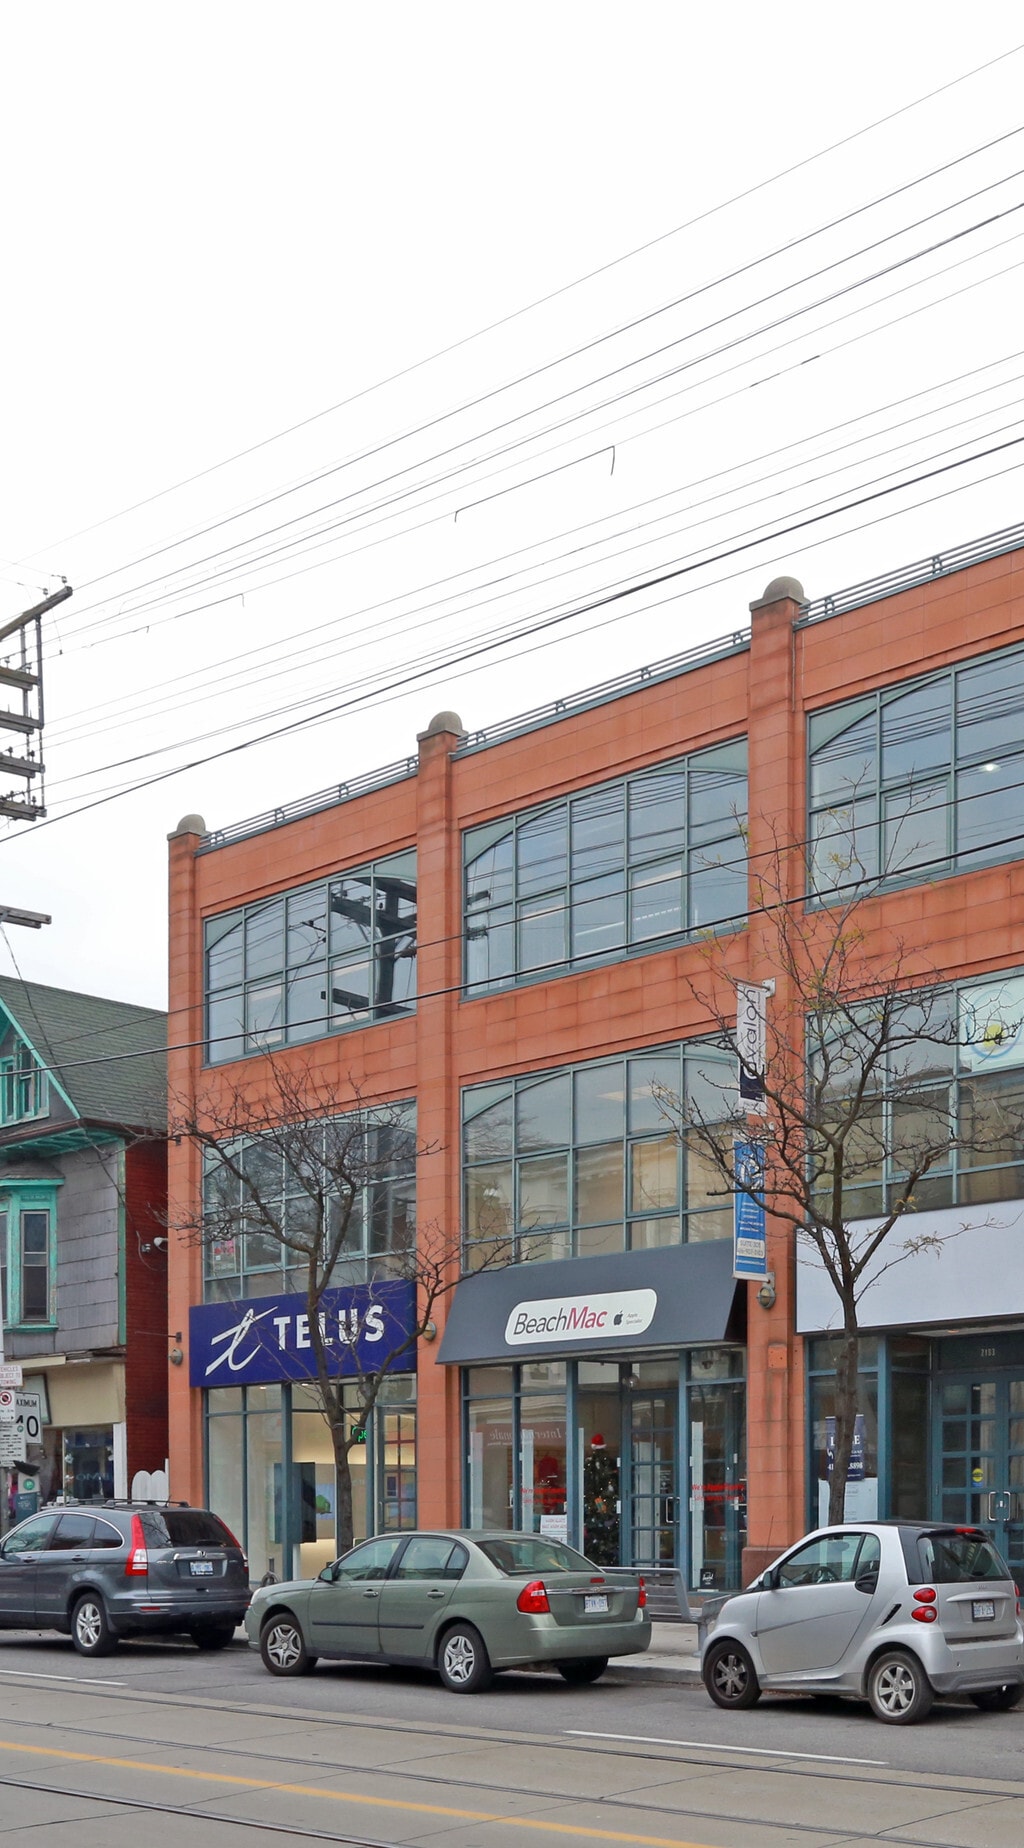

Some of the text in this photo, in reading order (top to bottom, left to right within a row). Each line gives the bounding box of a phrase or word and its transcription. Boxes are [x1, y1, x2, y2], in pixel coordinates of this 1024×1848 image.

[273, 1305, 385, 1350] TELUS
[513, 1306, 608, 1335] BeachMac
[15, 1399, 37, 1407] AXIMUM
